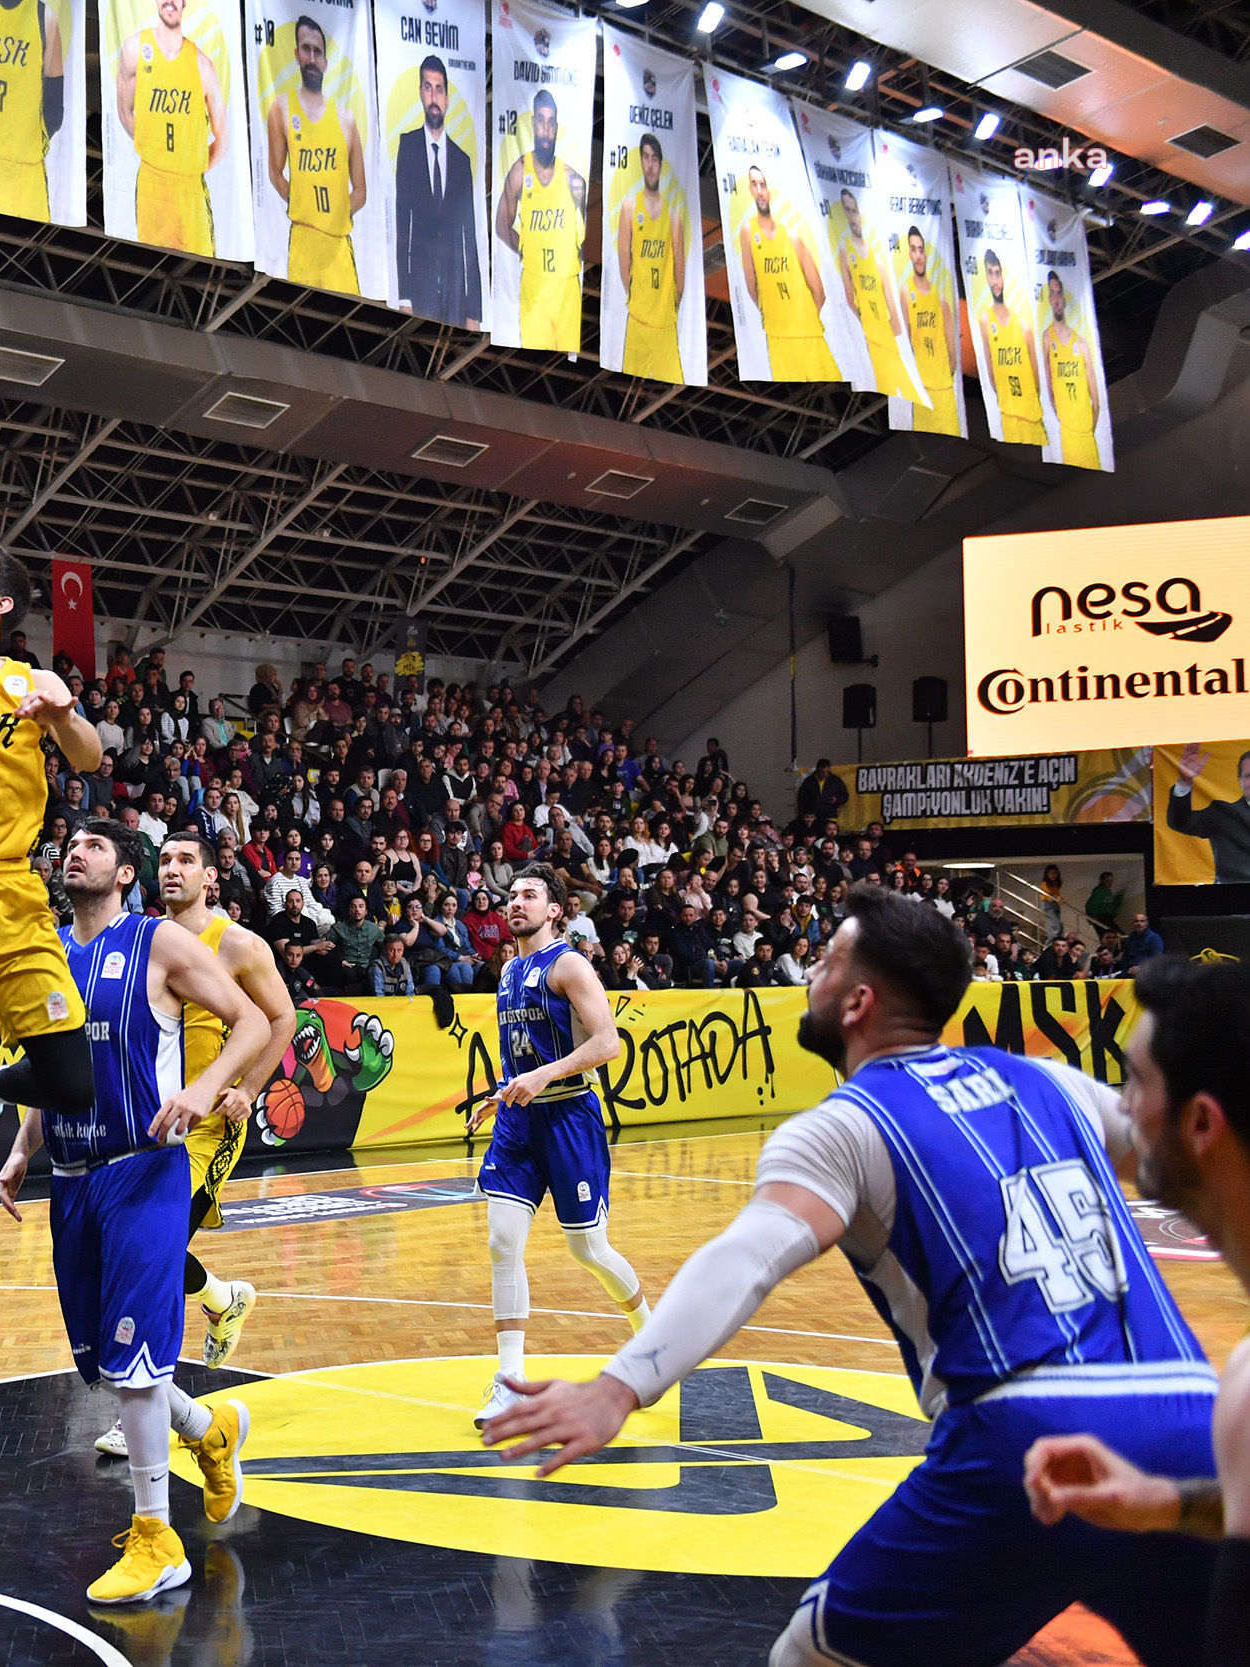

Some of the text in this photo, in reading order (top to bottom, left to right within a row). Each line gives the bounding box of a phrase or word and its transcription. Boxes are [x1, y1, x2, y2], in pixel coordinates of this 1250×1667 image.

[254, 17, 276, 48] #10
[401, 16, 459, 51] CAN SEVİM
[513, 61, 539, 84] DAVID
[149, 88, 192, 116] MSK
[498, 110, 518, 136] #12
[629, 104, 649, 128] DENİZ
[166, 123, 174, 152] 8
[298, 147, 338, 172] MSK
[610, 146, 628, 169] #13
[313, 185, 331, 214] 10
[529, 209, 565, 232] MSK
[543, 248, 556, 273] 12
[640, 239, 666, 259] MSK
[651, 267, 660, 290] 13
[764, 257, 789, 275] MSK
[776, 282, 791, 300] 14
[998, 347, 1023, 367] MSK
[1057, 361, 1079, 378] MSK
[1031, 577, 1201, 638] nesa
[1047, 619, 1124, 635] lastik
[977, 657, 1249, 715] Continental
[858, 757, 1076, 792] BAYRAKLARI AKDENİZ'E AÇIN
[883, 787, 1049, 822] ŞAMPİYONLUK YAKIN!
[511, 1029, 534, 1058] 24
[962, 982, 1127, 1084] MSK
[924, 1066, 1017, 1115] SARI
[997, 1158, 1129, 1315] 45
